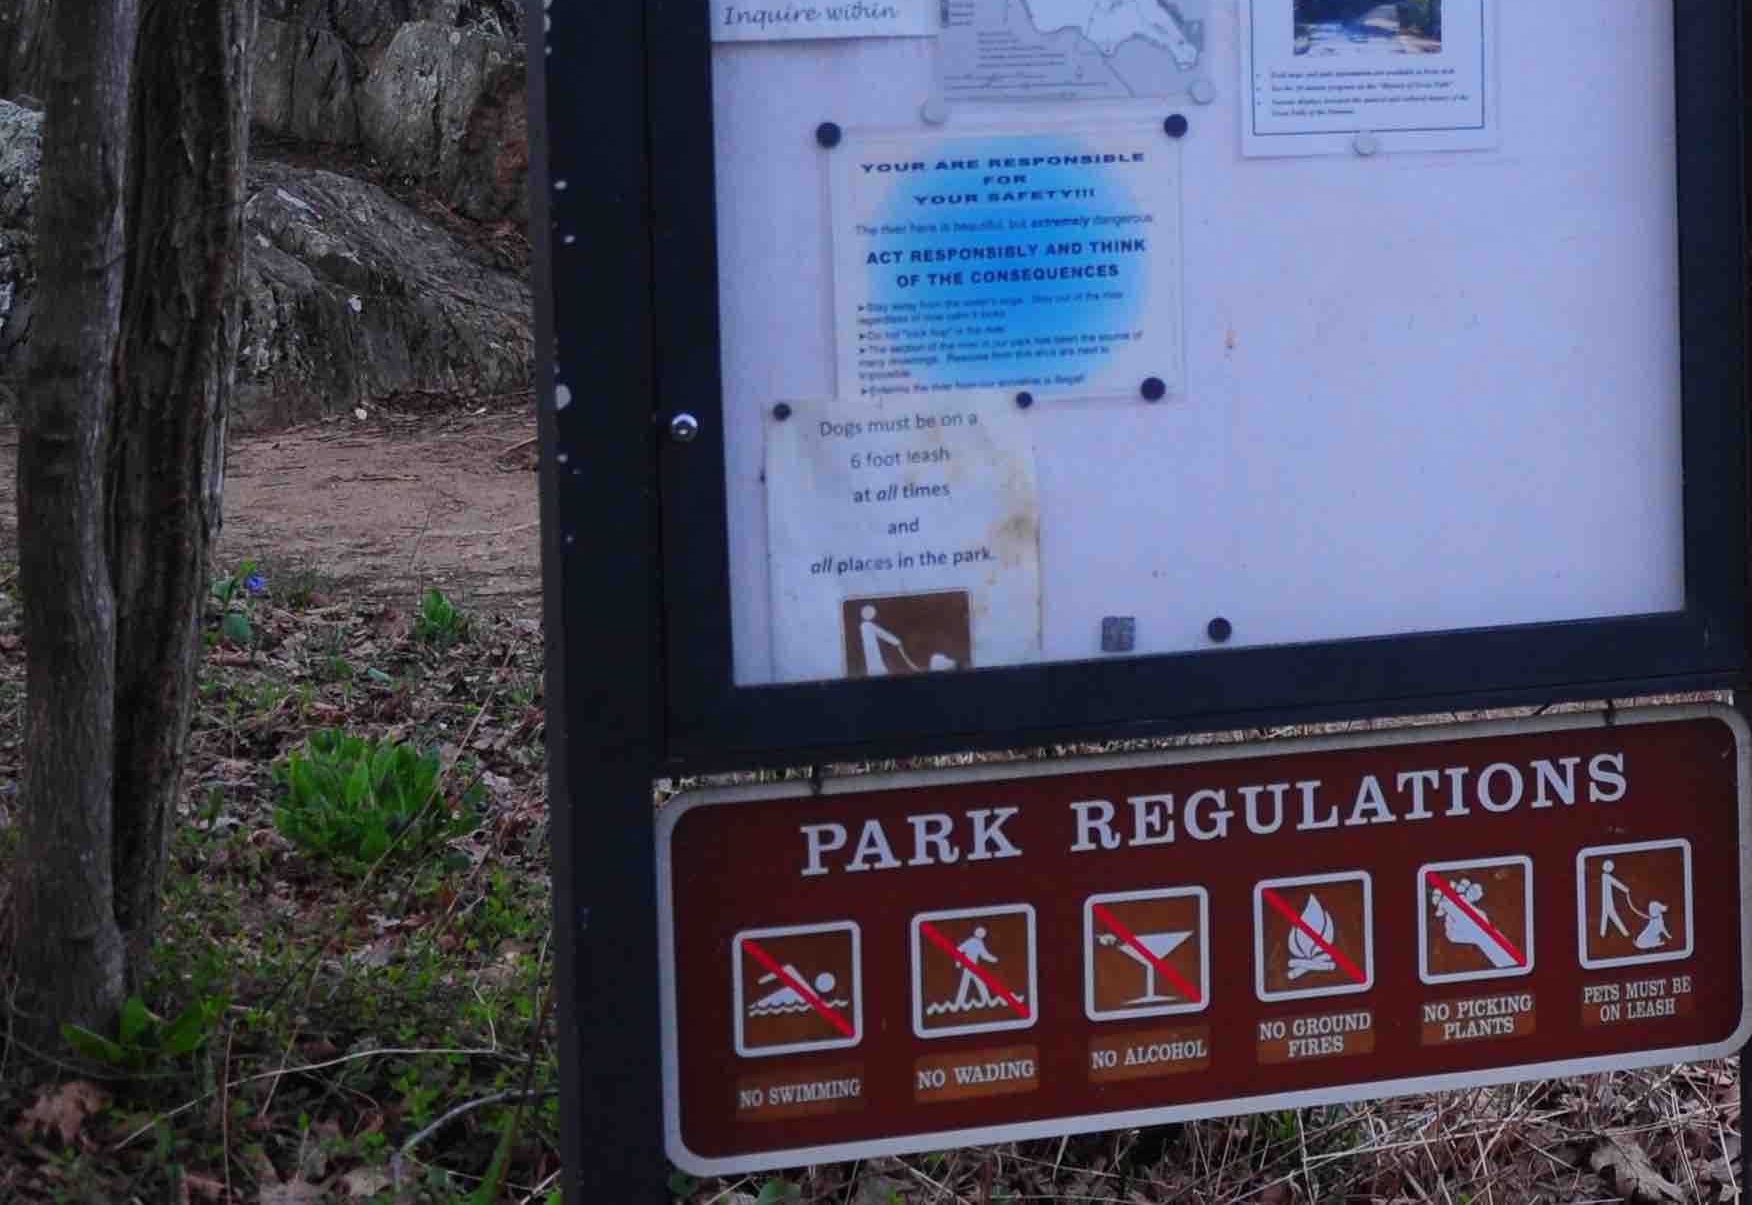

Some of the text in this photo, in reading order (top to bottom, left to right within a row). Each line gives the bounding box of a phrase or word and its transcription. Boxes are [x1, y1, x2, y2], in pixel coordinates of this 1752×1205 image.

[723, 0, 897, 30] Inquire within
[861, 151, 1146, 174] YOUR ARE RESPONSIBLE
[983, 174, 1027, 186] FOR
[914, 188, 1096, 206] YOUR SAFETY!!!
[1030, 214, 1090, 230] extremely
[866, 238, 1147, 266] ACT RESPONSIBLY AND THINK
[895, 264, 1120, 289] OF THE CONSEQUENCES
[819, 413, 978, 437] Dogs must be on a
[850, 447, 950, 469] 6 foot leash
[852, 482, 951, 504] at all times
[887, 518, 920, 536] and
[810, 546, 997, 576] all places in the park.
[800, 752, 1628, 878] PARK REGULATIONS
[1583, 976, 1692, 1005] PETS MUST BE
[1424, 995, 1534, 1023] NO PICKING
[1599, 997, 1676, 1022] ON LEASH
[1258, 1012, 1371, 1041] NO GROUND
[1443, 1016, 1515, 1041] PLANTS
[1090, 1038, 1208, 1070] NO ALCOHOL
[1287, 1035, 1345, 1059] FIRES
[917, 1059, 1036, 1090] NO WADING
[739, 1077, 862, 1109] NO SWIMMING
